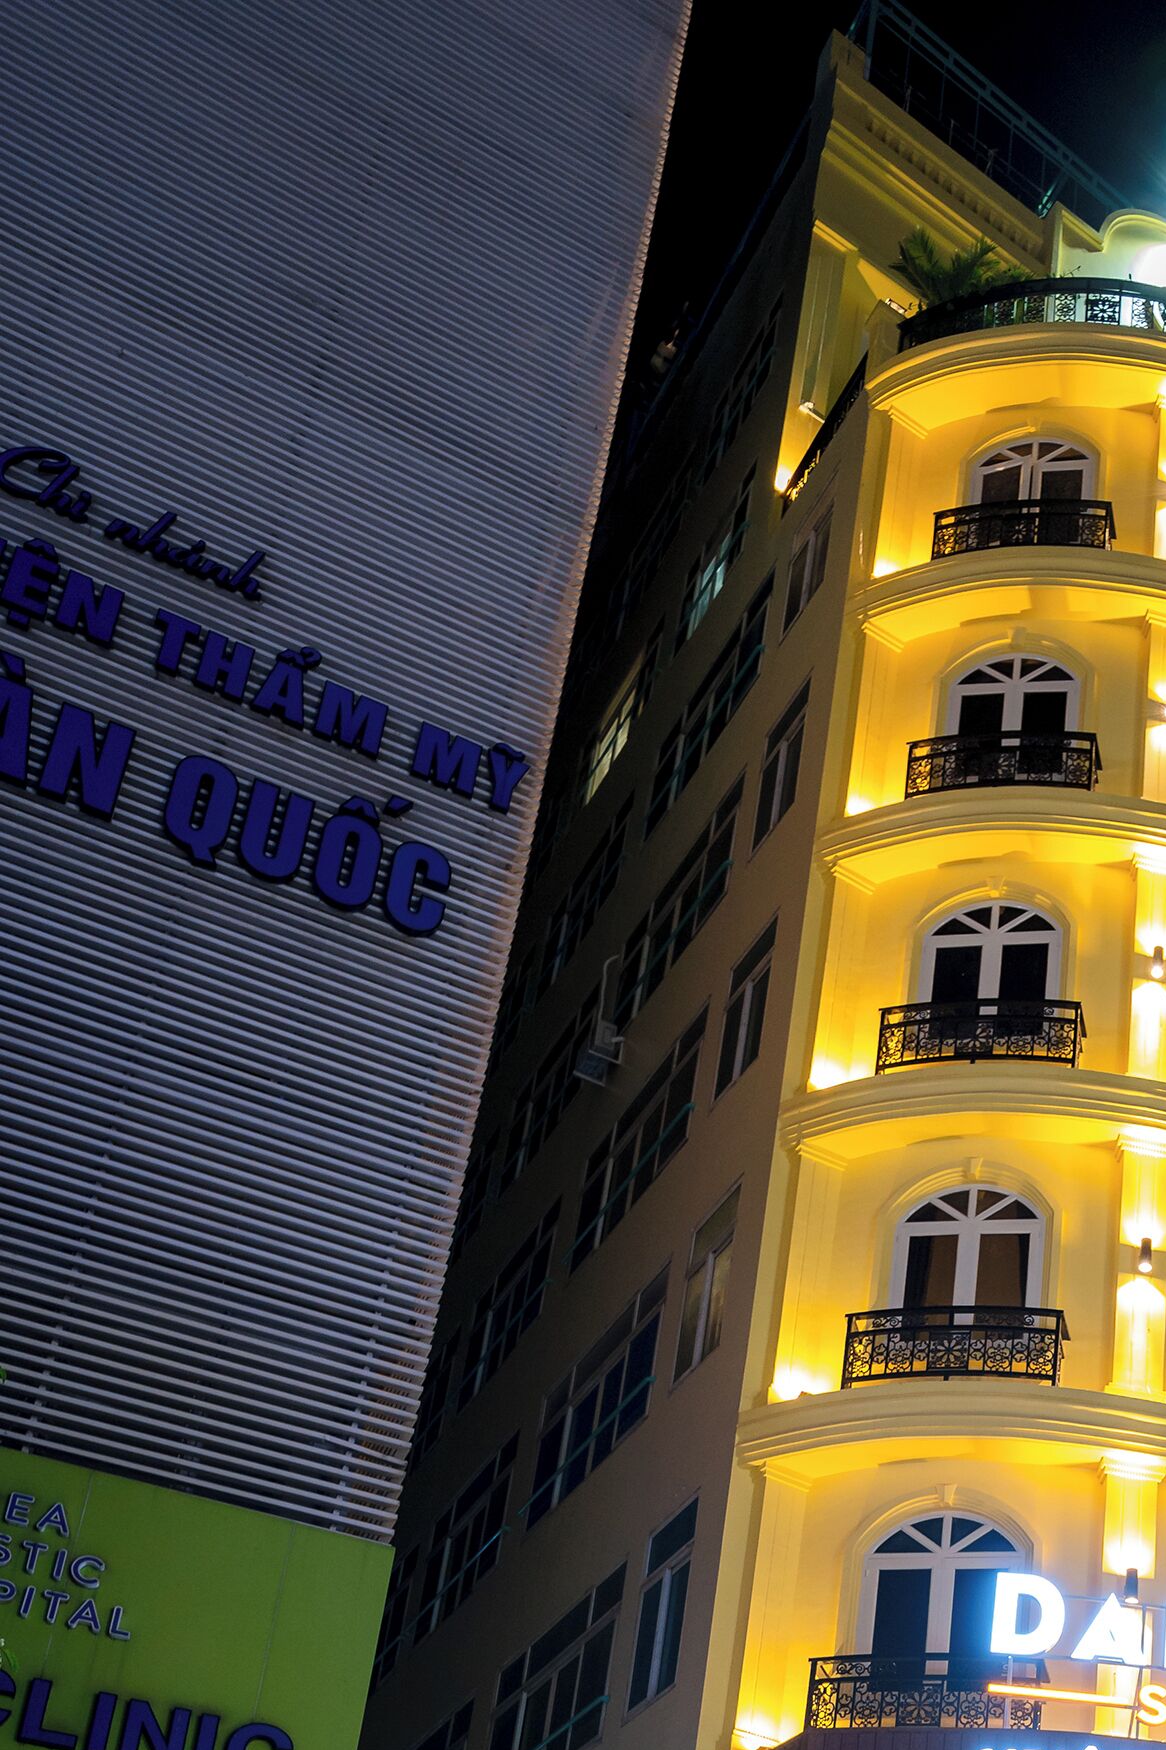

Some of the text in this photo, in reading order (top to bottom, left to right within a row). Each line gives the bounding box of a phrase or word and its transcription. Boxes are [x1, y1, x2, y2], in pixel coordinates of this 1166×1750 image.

[0, 446, 267, 600] Chi nhánh
[0, 537, 530, 815] ỆN THẨM MỸ
[163, 755, 452, 936] QUỐC
